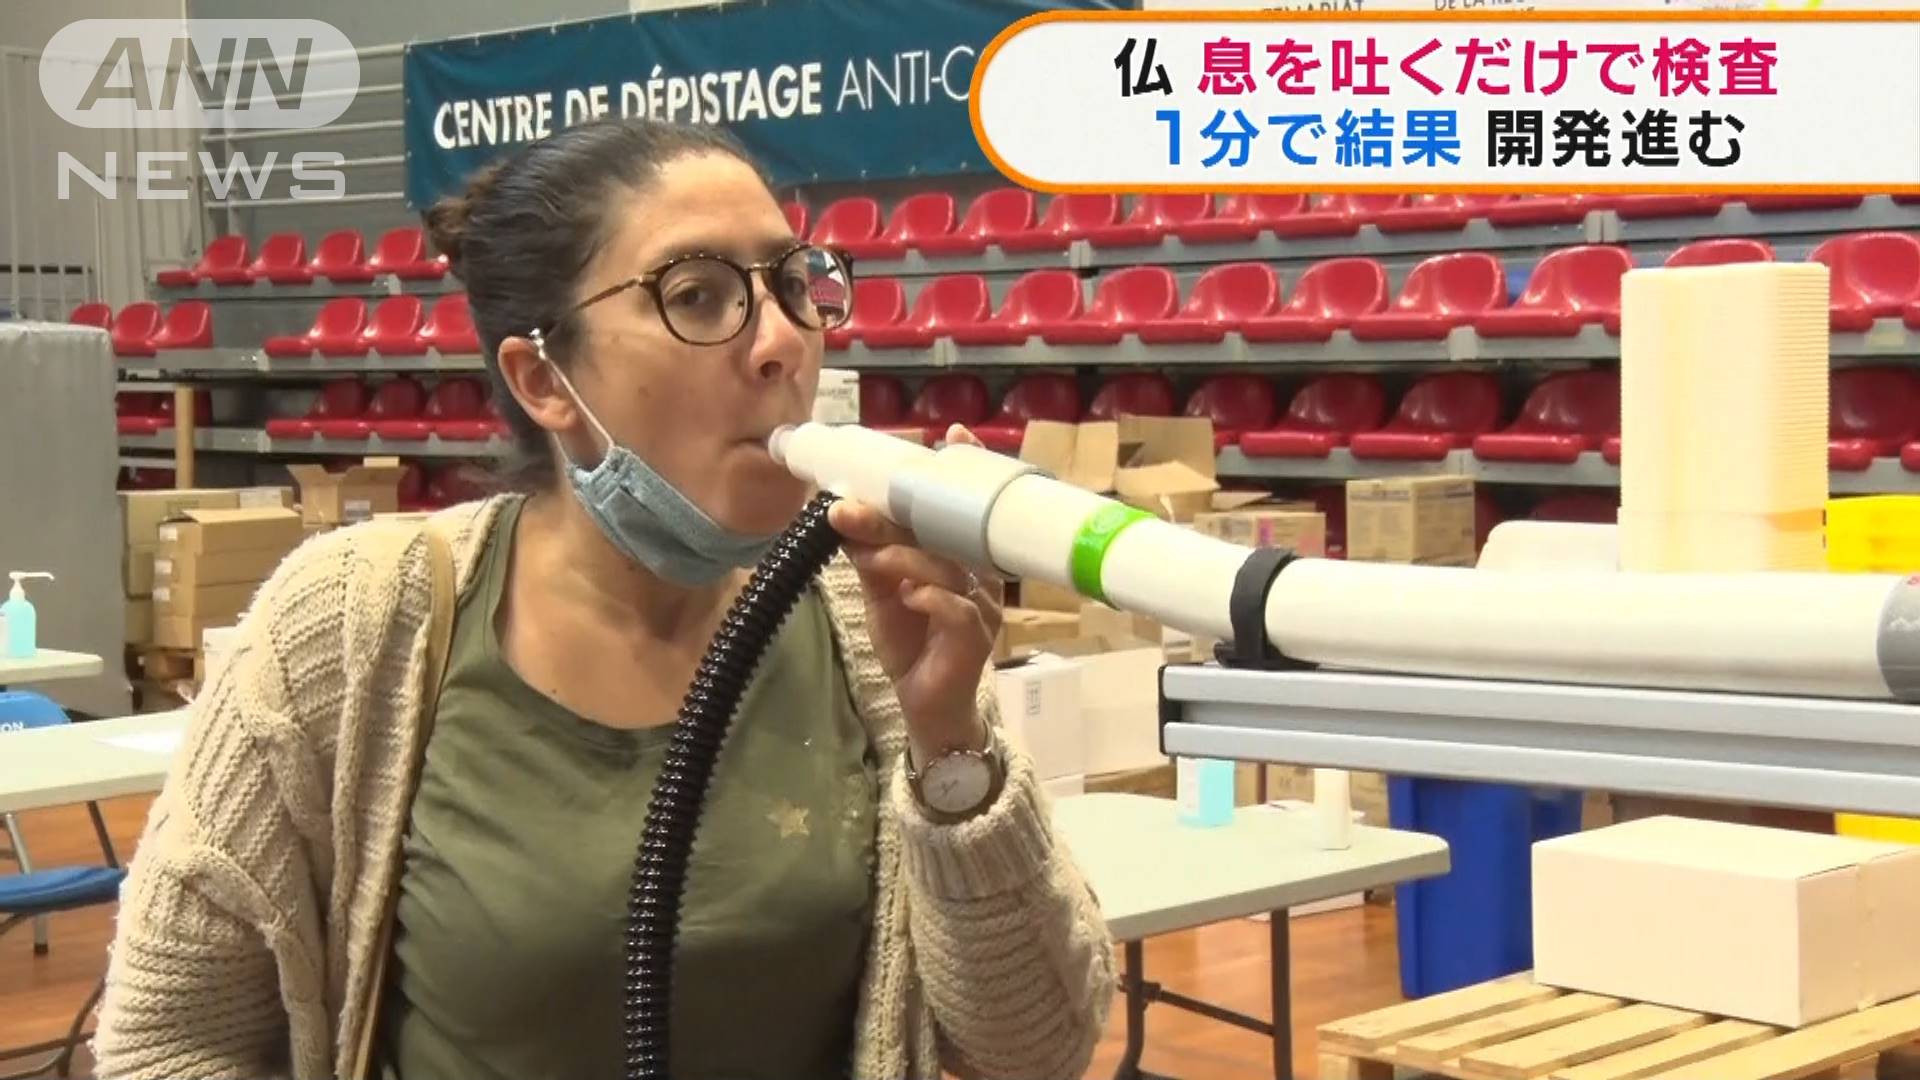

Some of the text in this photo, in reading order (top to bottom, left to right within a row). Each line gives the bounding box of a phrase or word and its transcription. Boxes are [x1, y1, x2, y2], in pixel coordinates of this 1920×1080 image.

[433, 92, 553, 149] CENTRE
[564, 86, 609, 128] DE
[621, 62, 822, 125] DÉPISTAGE
